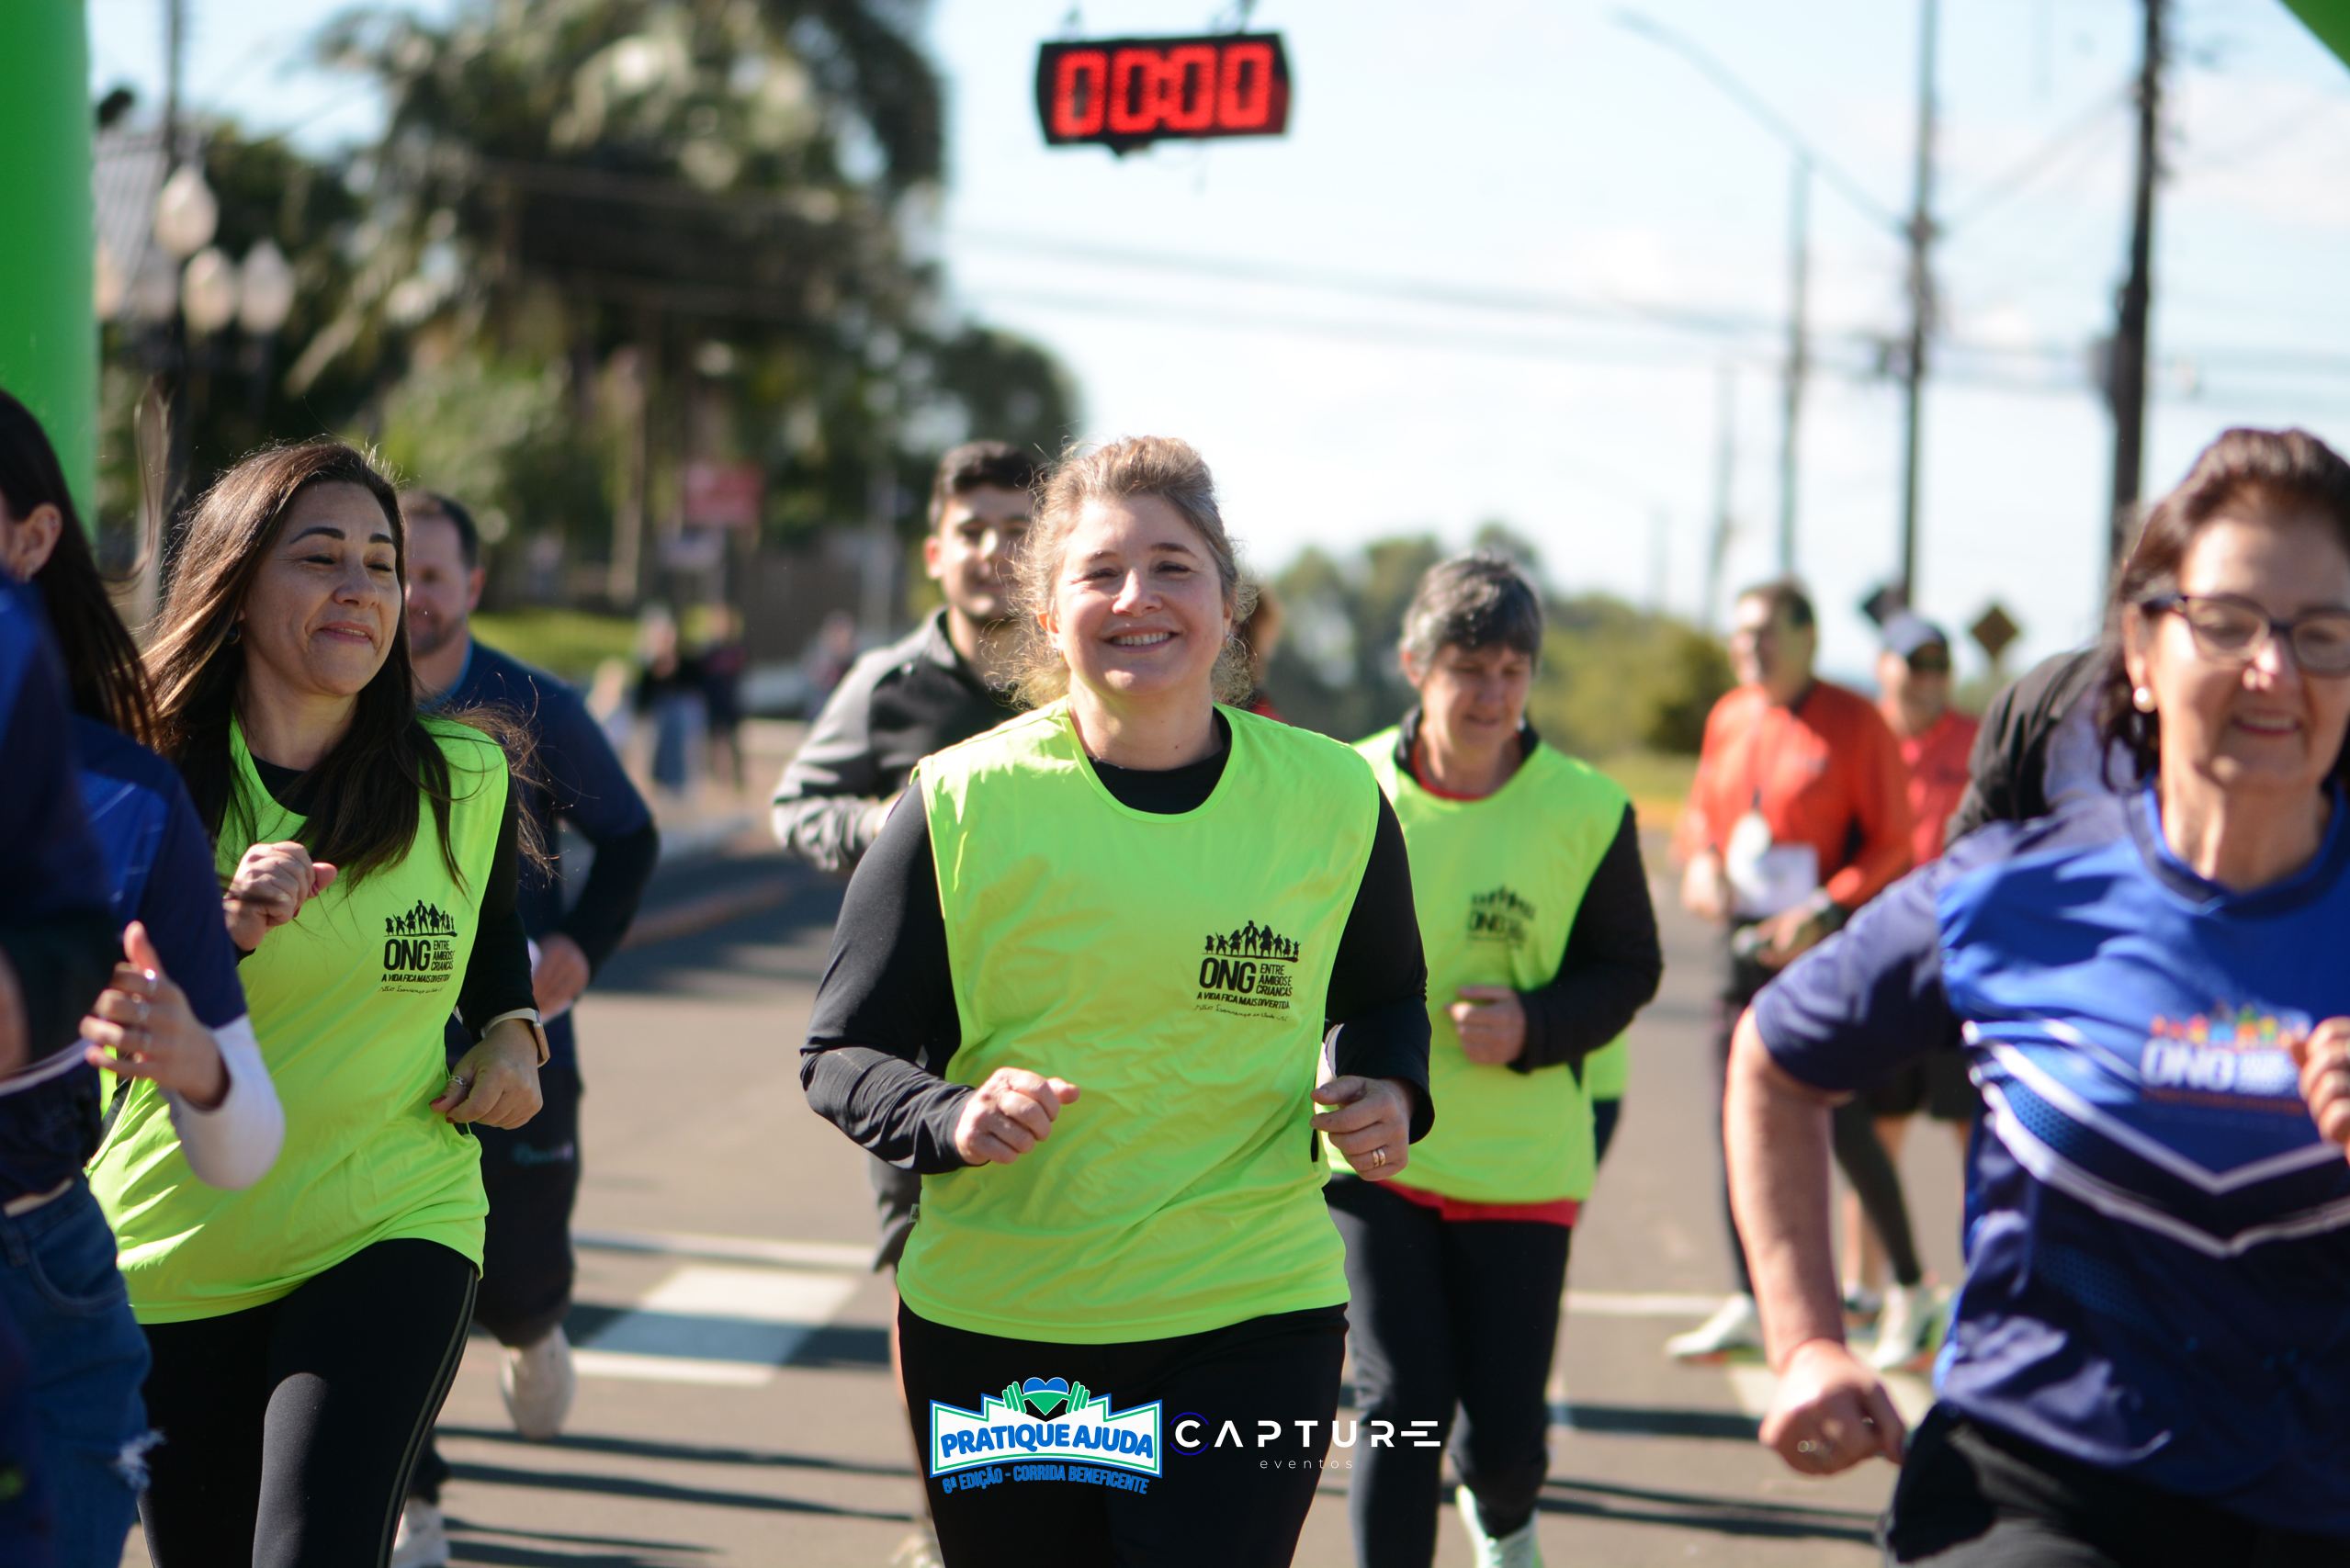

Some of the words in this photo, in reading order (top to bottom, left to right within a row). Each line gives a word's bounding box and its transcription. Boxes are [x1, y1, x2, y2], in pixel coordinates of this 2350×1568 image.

[1052, 40, 1274, 138] 00:00
[434, 941, 449, 950] ENTRE
[383, 938, 432, 972] ONG
[1199, 956, 1257, 994] ONG
[1260, 964, 1285, 975] ENTRE
[381, 974, 387, 982] A
[388, 974, 402, 983] VIDA
[403, 974, 416, 983] FICA
[417, 974, 431, 983] MAIS
[1259, 975, 1287, 986] AMIGOS
[1203, 992, 1221, 1001] VIDA
[1221, 994, 1237, 1004] FICA
[1238, 996, 1257, 1006] MAIS
[1257, 998, 1291, 1010] DIVERTIDA
